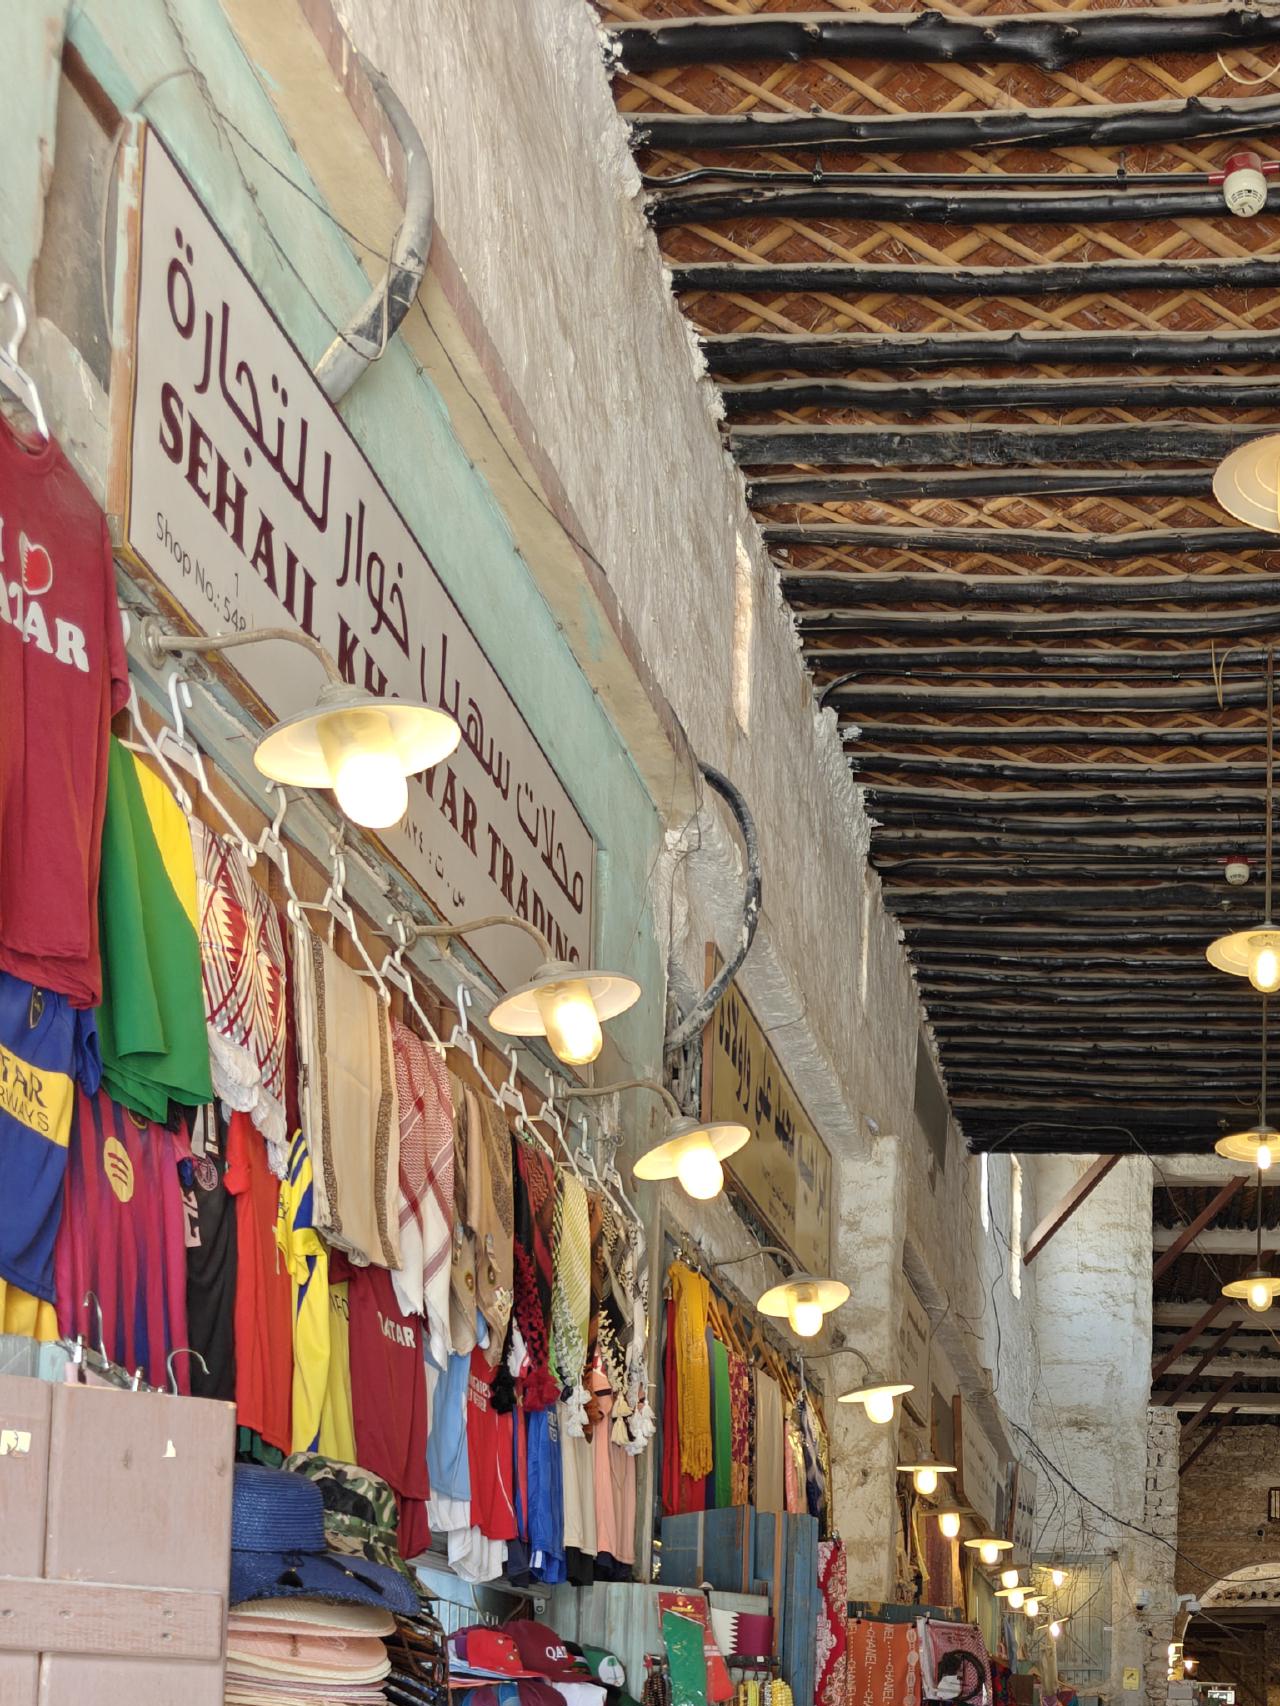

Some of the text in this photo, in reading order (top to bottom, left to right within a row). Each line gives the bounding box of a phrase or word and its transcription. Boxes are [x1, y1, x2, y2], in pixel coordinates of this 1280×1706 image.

[167, 227, 332, 533] للتجارة
[156, 512, 191, 575] Shop
[159, 381, 322, 643] SEHAIL
[336, 498, 410, 660] خوار
[516, 782, 584, 915] محلات
